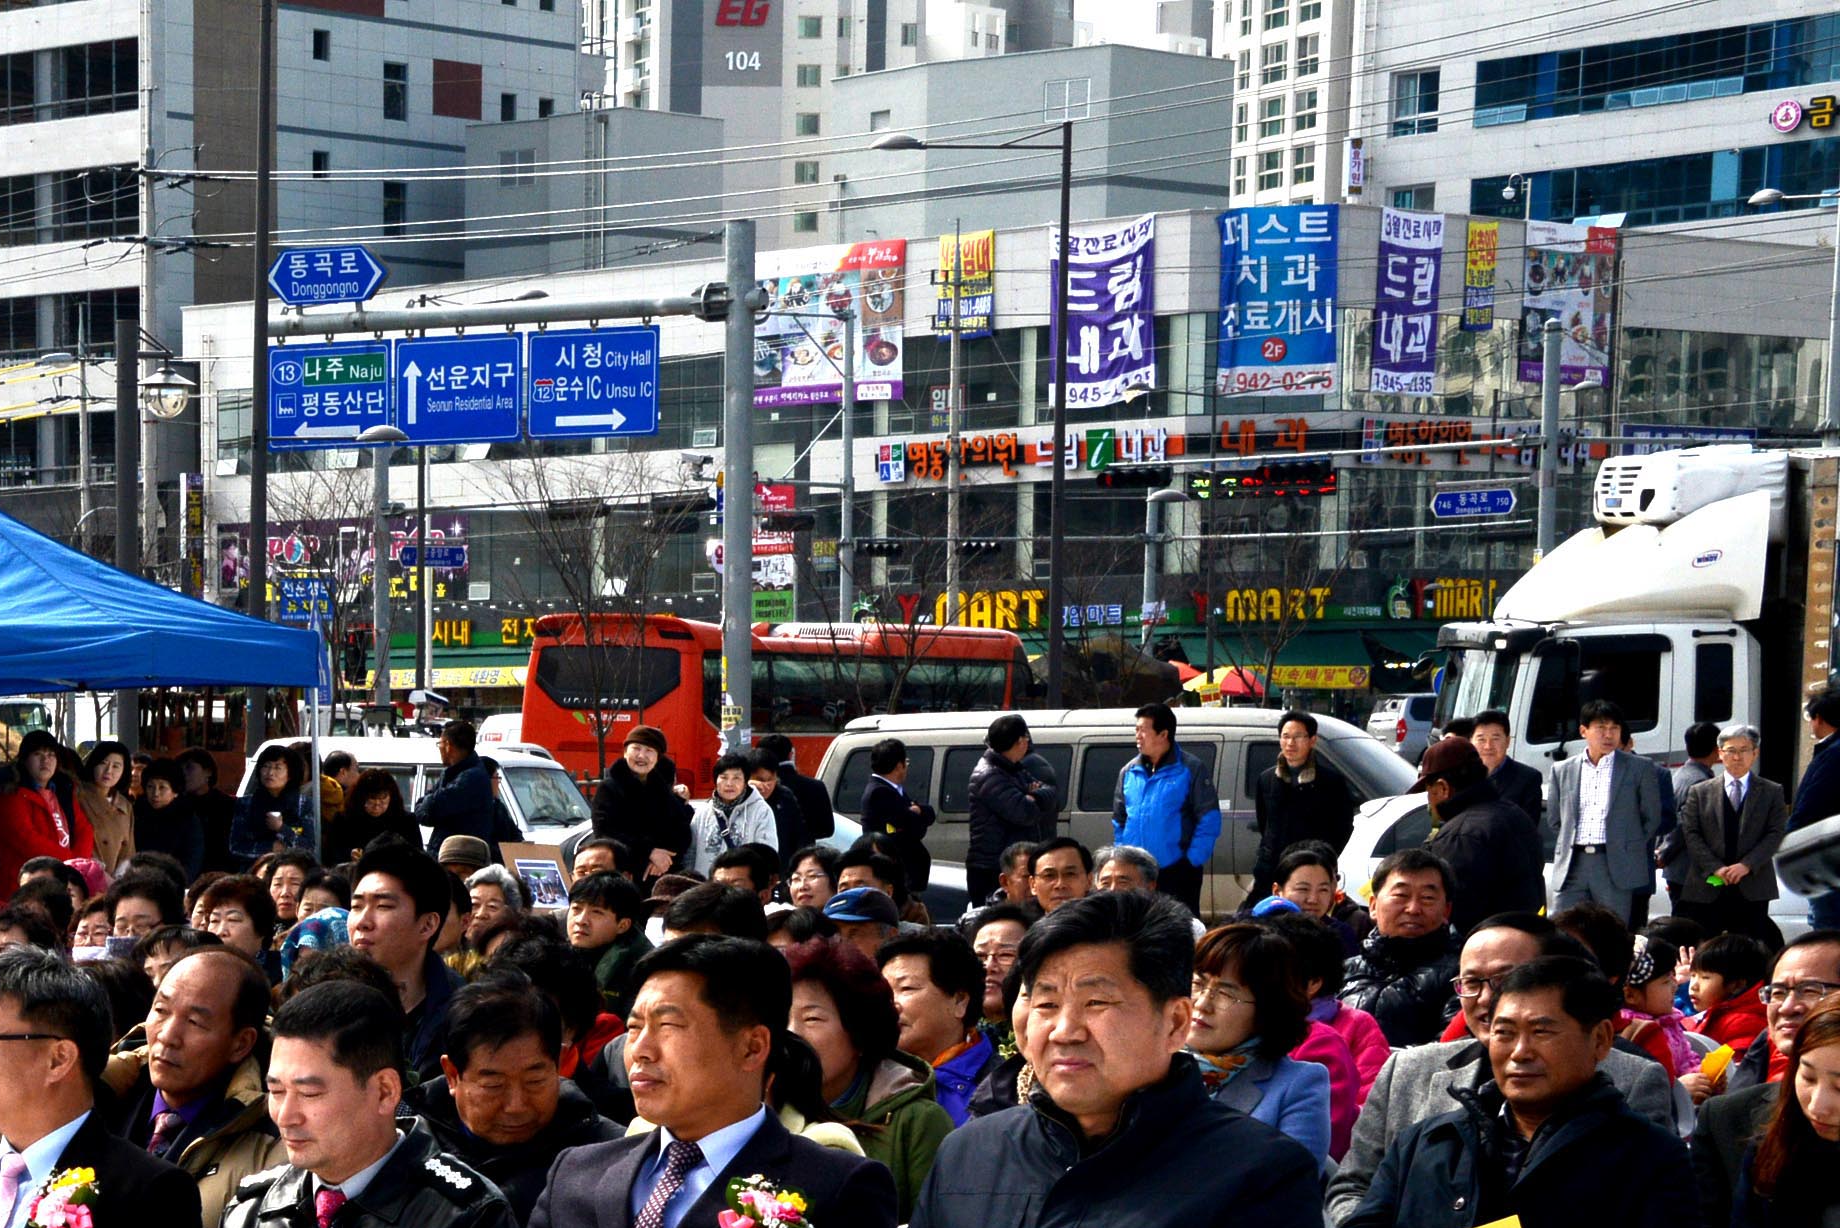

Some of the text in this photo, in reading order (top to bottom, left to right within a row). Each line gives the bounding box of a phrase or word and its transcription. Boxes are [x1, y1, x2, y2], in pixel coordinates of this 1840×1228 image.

[726, 51, 761, 71] 104
[1223, 210, 1333, 252] 퍼스트
[288, 252, 360, 279] 동곡로
[1235, 253, 1321, 294] 치과
[1384, 252, 1435, 306] 드림
[291, 279, 360, 299] Donggongno
[1221, 297, 1333, 338] 진료개시
[1263, 342, 1284, 358] 2F
[1380, 311, 1431, 364] 내과
[278, 357, 383, 381] 13 나주 Naju
[555, 342, 652, 370] 시청 City Hall
[425, 362, 516, 391] 선운지구
[537, 376, 653, 402] 12 운수IC Unsu IC
[301, 389, 385, 417] 평동산단
[426, 395, 514, 414] Seonun Residential Area
[1221, 417, 1309, 455] 내과
[1458, 492, 1489, 506] 동곡로
[935, 589, 1045, 630] MART
[1225, 587, 1332, 622] MART
[431, 618, 472, 647] 시내
